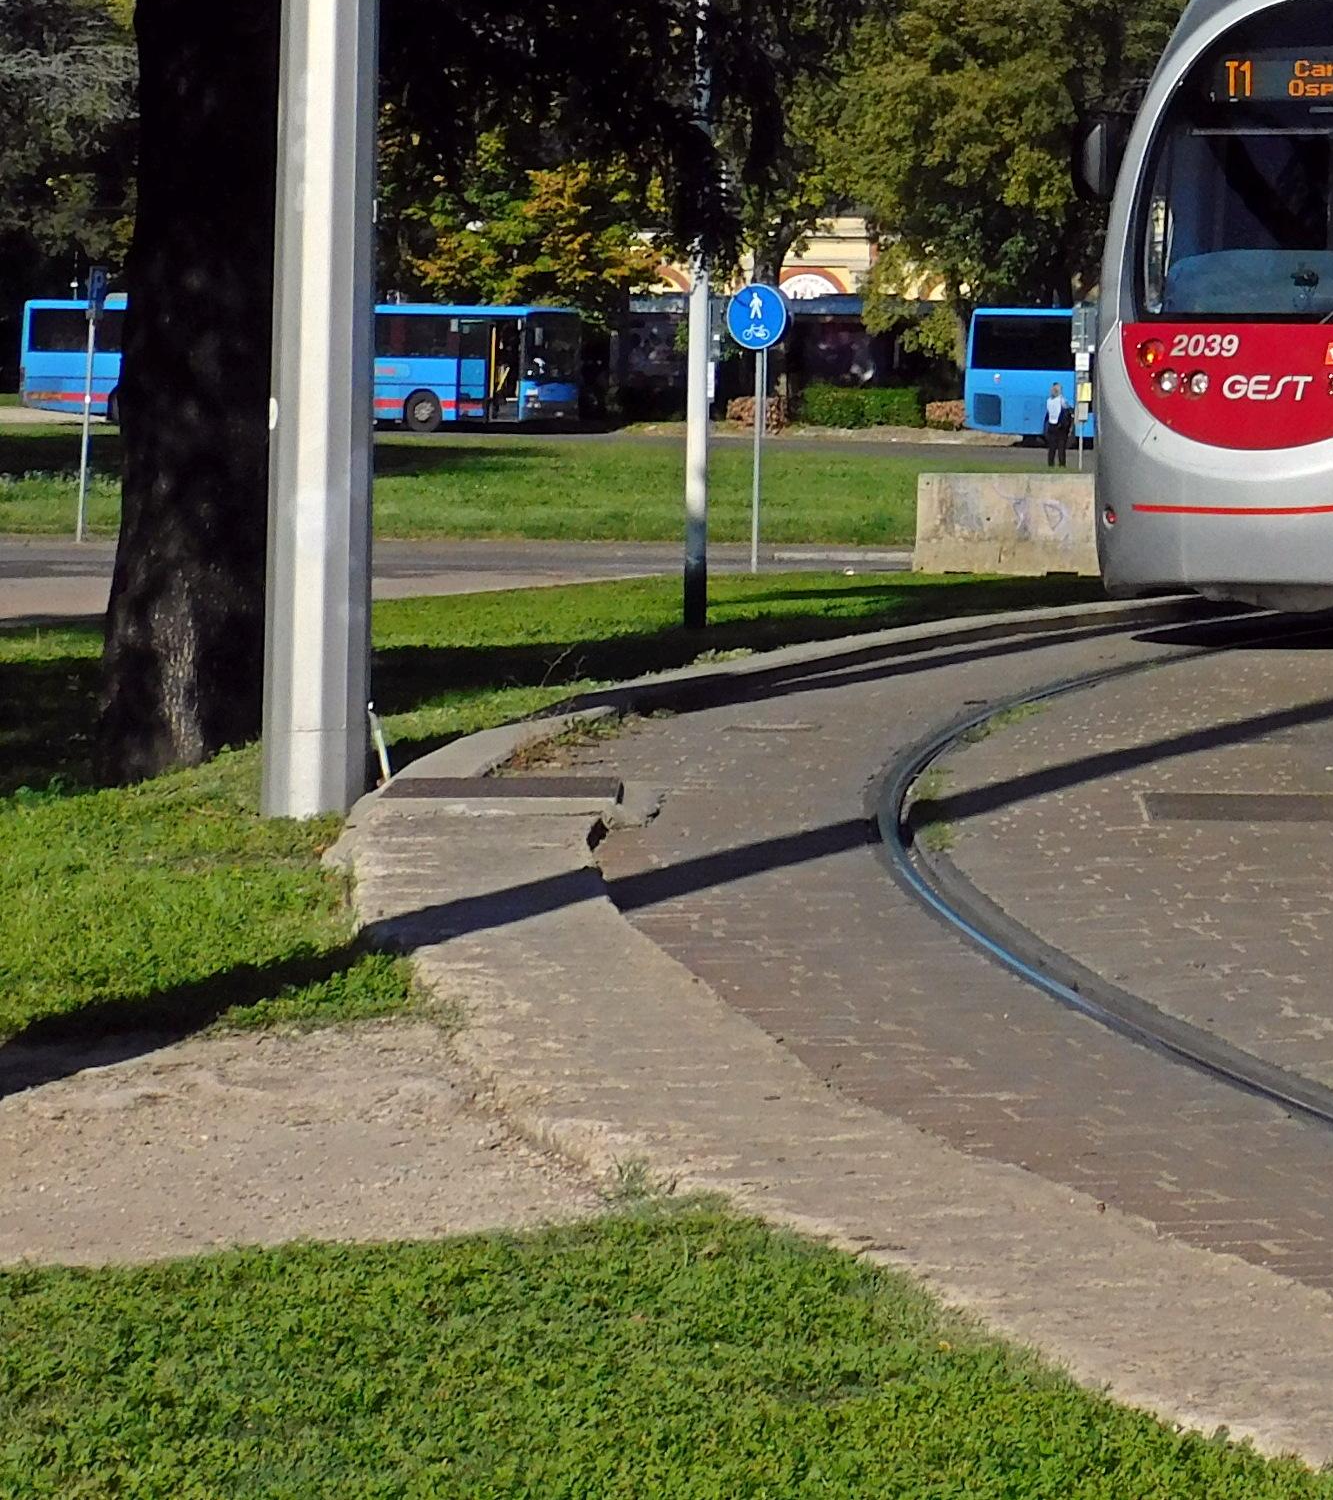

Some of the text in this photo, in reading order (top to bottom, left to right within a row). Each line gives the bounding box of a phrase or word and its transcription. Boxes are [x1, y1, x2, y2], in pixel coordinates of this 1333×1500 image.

[1225, 60, 1252, 97] T1
[1169, 334, 1240, 358] 2039
[1222, 375, 1313, 401] GEST
